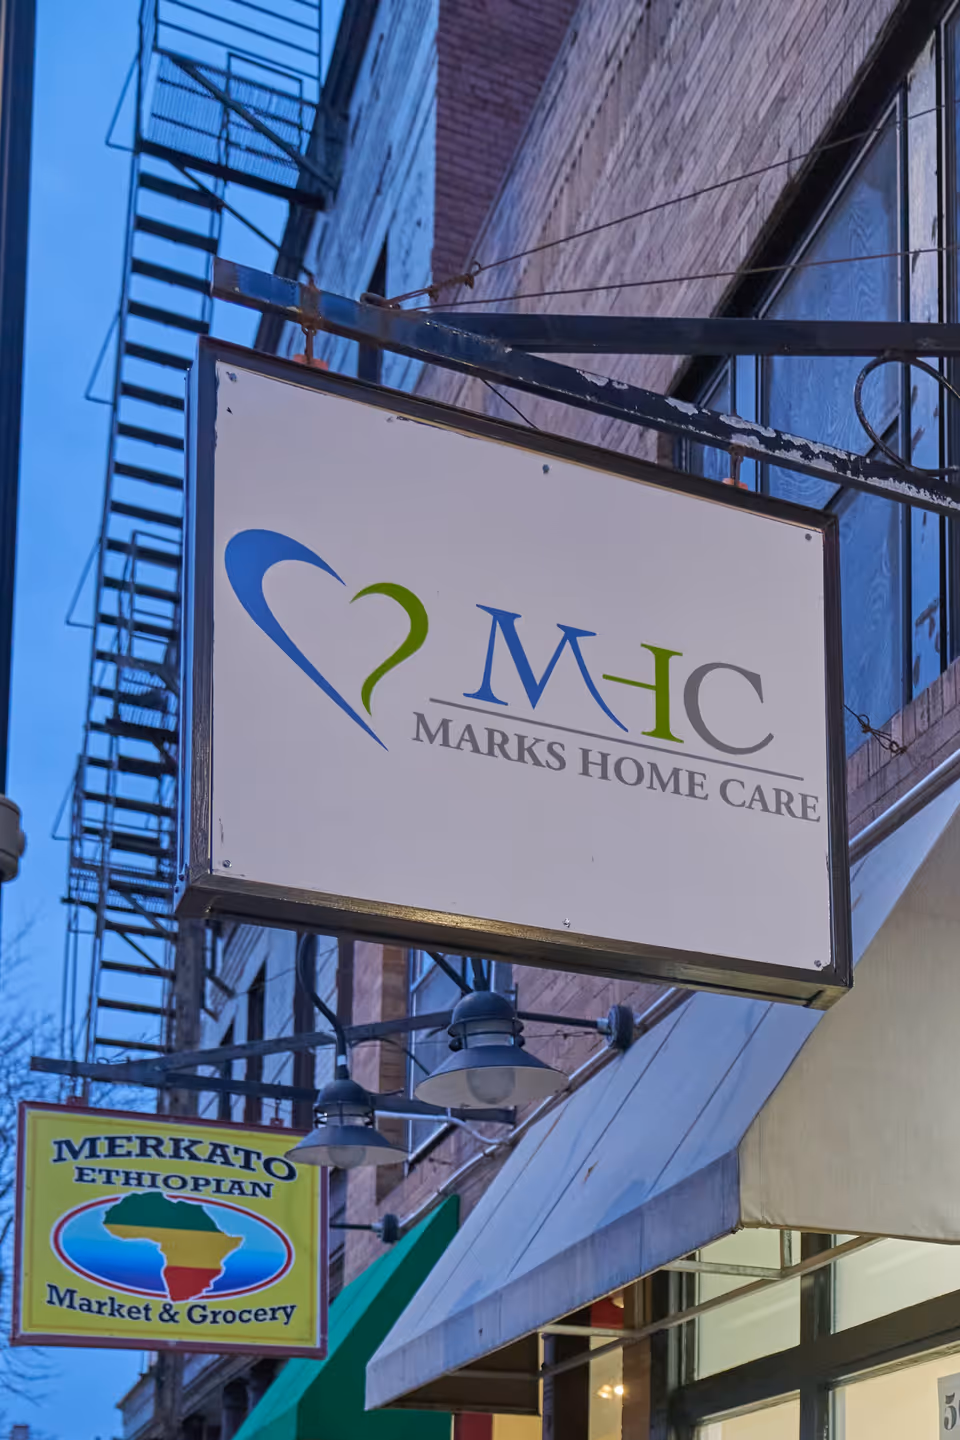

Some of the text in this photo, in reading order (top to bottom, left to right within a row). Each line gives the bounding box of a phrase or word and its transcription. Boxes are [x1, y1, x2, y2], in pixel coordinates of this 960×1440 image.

[463, 604, 774, 754] MHC
[412, 712, 821, 822] MARKS HOME CARE
[53, 1136, 297, 1182] MERKATO
[74, 1166, 274, 1199] ETHIOPIAN
[47, 1283, 297, 1325] Market & Grocery
